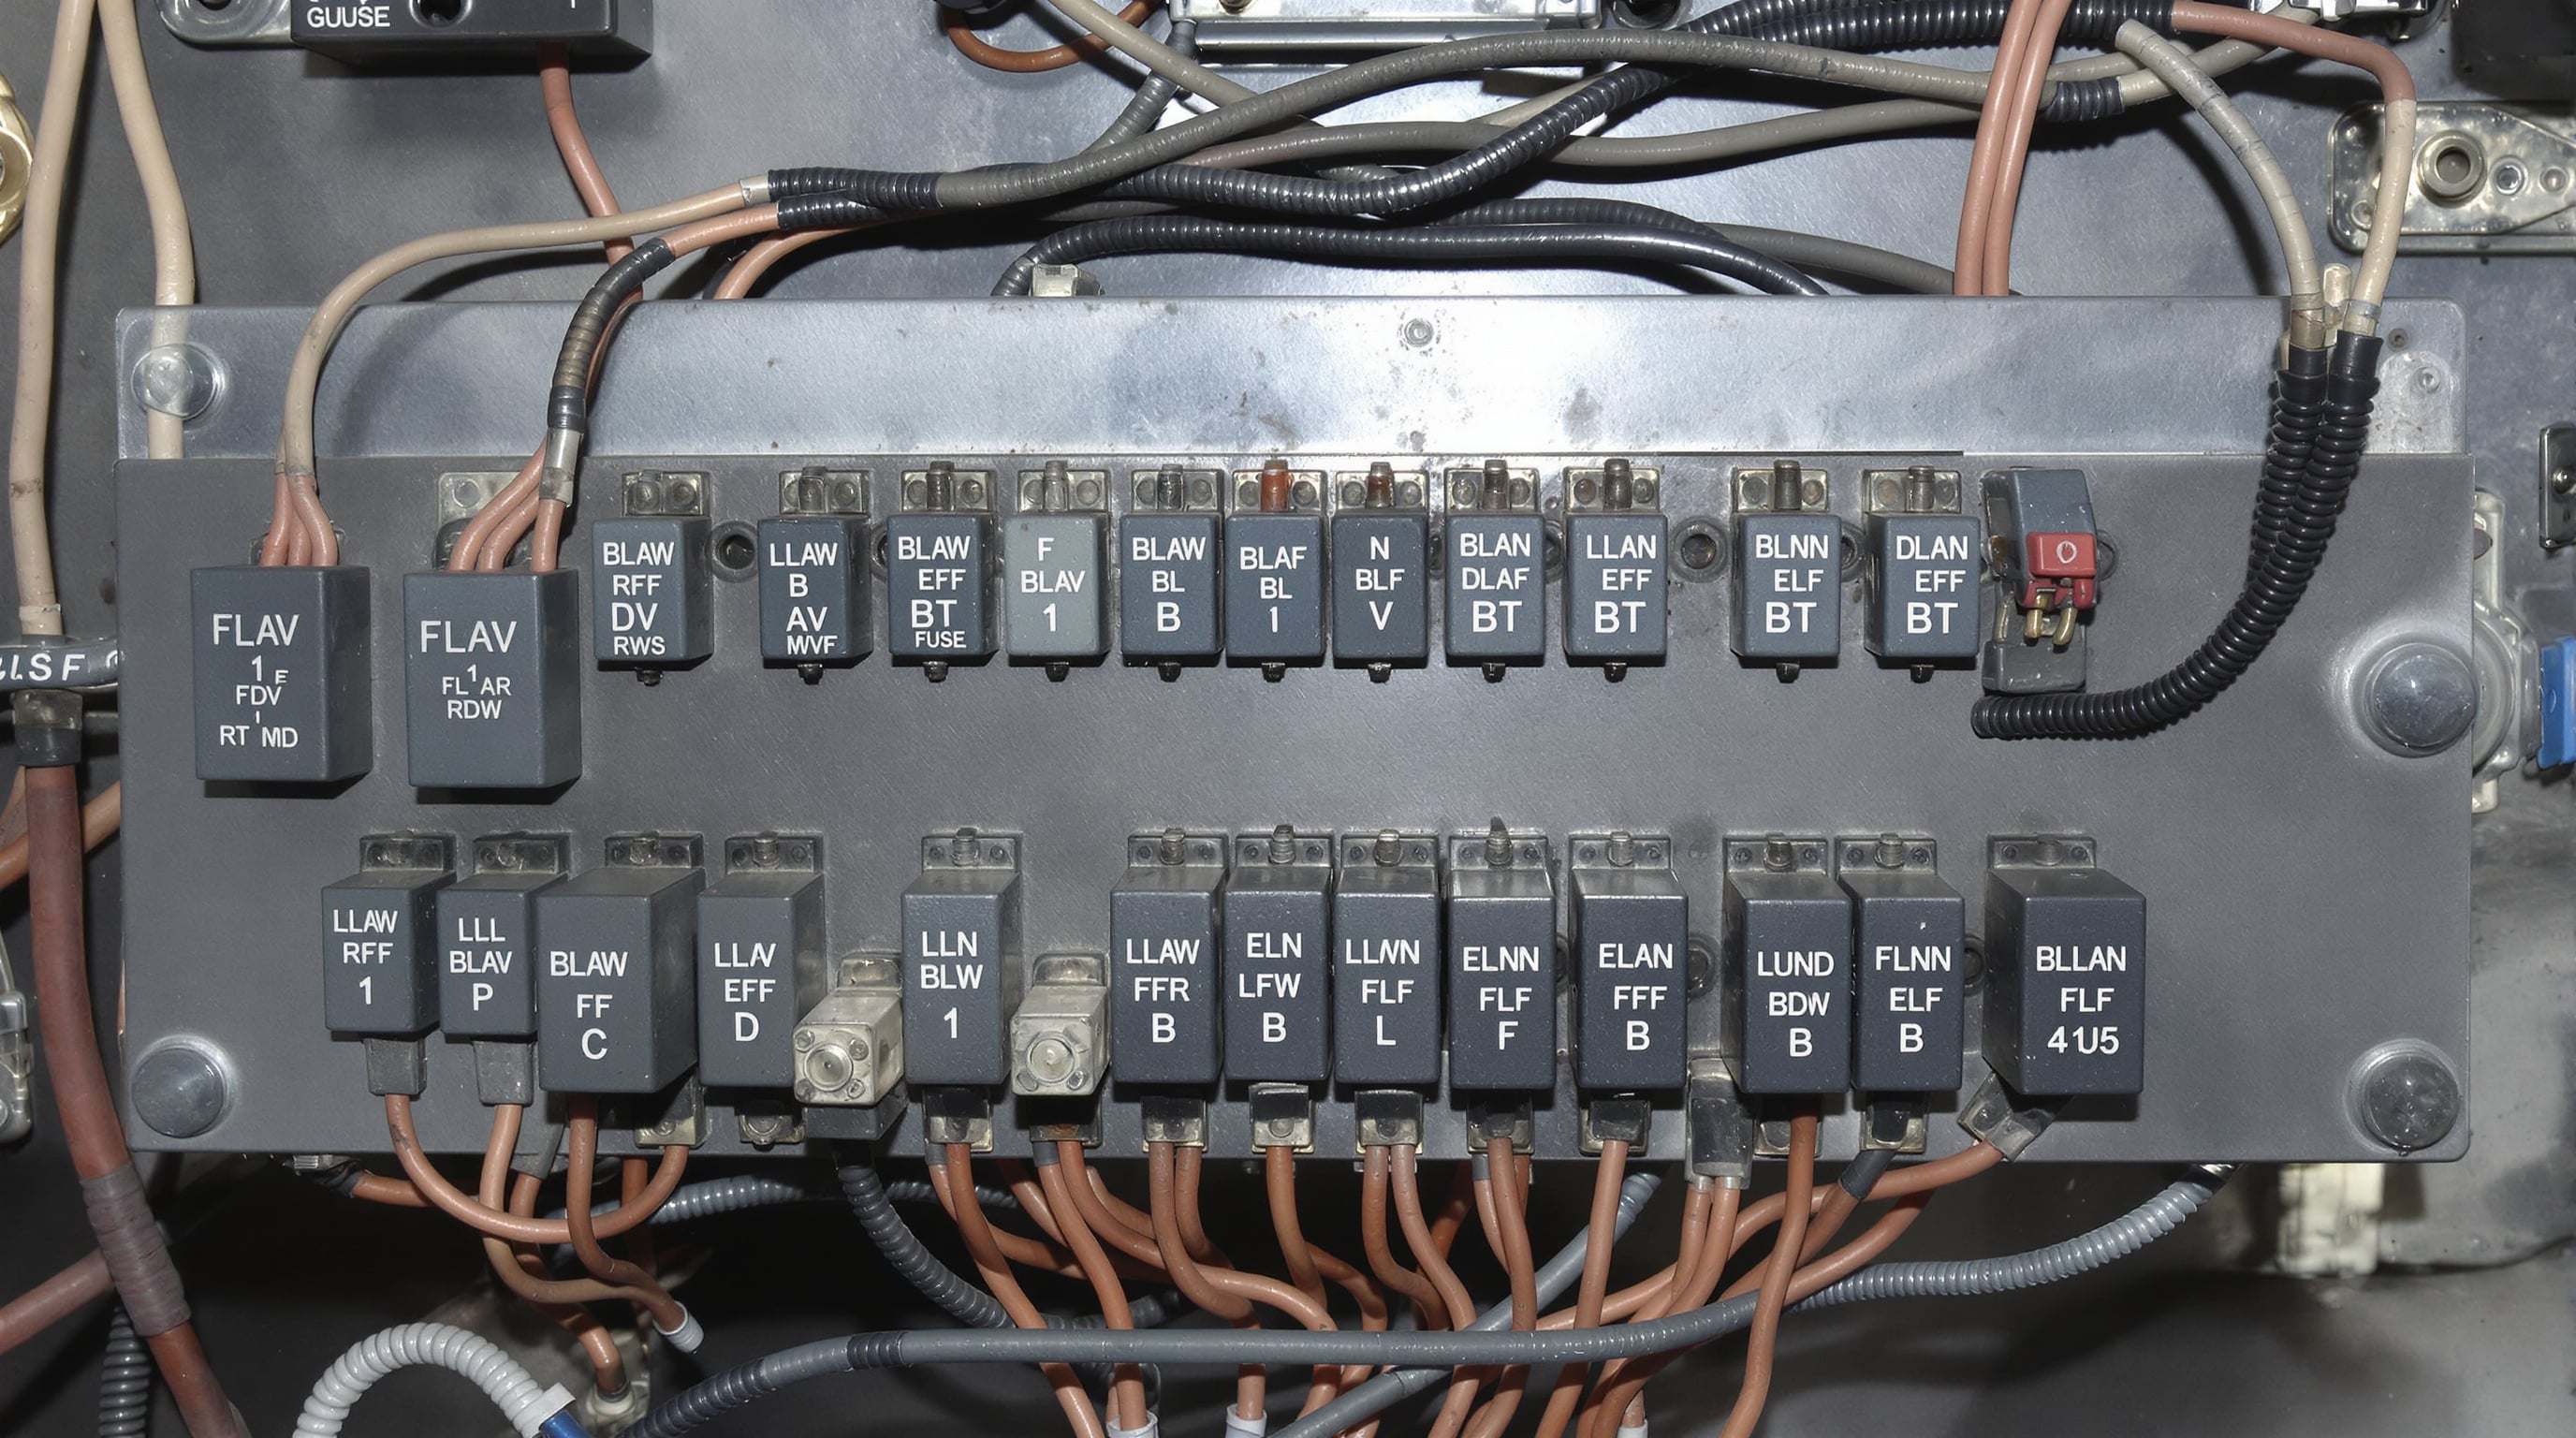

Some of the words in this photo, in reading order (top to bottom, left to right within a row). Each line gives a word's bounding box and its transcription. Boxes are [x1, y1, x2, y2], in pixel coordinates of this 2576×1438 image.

[307, 6, 389, 27] GUUSE
[603, 541, 674, 565] BLAW
[769, 542, 837, 565] LLAW
[898, 536, 970, 560] BLAW
[1038, 536, 1054, 561] F
[1132, 536, 1206, 560] BLAW
[1370, 536, 1389, 559] N
[1459, 532, 1530, 556] BLAN
[1587, 534, 1656, 559] LLAN
[1755, 534, 1828, 558] BLNN
[1895, 535, 1968, 559] DLAN
[1239, 546, 1307, 569] BLAF
[612, 574, 662, 595] RFF
[789, 573, 808, 596] B
[918, 568, 966, 590] EFF
[1020, 569, 1085, 593] BLAV
[1151, 570, 1185, 592] BL
[1260, 577, 1292, 598] BL
[1355, 568, 1404, 590] BLF
[1461, 566, 1530, 590] DLAF
[1602, 568, 1652, 590] EFF
[1774, 568, 1823, 592] ELF
[1915, 569, 1966, 592] EFF
[611, 602, 657, 631] DV
[785, 606, 827, 631] AV
[911, 599, 957, 627] BT
[1043, 603, 1056, 631] 1
[1157, 601, 1180, 631] B
[1269, 606, 1278, 632] 1
[1368, 600, 1393, 630] V
[1472, 600, 1522, 632] BT
[1594, 600, 1646, 633] BT
[1765, 601, 1817, 633] BT
[1907, 601, 1958, 633] BT
[212, 613, 299, 646] FLAV
[420, 620, 517, 653] FLAV
[915, 630, 966, 648] FUSE
[613, 636, 665, 655] RWS
[251, 654, 261, 681] 1
[467, 664, 476, 682] 1
[236, 684, 281, 705] FDV
[442, 676, 468, 695] FL
[480, 676, 511, 696] AR
[447, 699, 502, 718] RDW
[219, 725, 249, 745] RT
[261, 726, 298, 747] MD
[333, 909, 398, 932] LLAW
[458, 917, 505, 942] LLL
[343, 942, 393, 963] RFF
[922, 931, 976, 957] LLN
[1126, 938, 1199, 964] LLAW
[1247, 932, 1301, 958] ELN
[1599, 943, 1672, 968] ELAN
[449, 950, 512, 974] BLAV
[550, 950, 627, 976] BLAW
[1463, 946, 1538, 971] ELNN
[1757, 950, 1834, 976] LUND
[1876, 946, 1950, 971] FLNN
[2036, 946, 2126, 971] BLLAN
[920, 963, 983, 989] BLW
[1134, 976, 1190, 1001] FFR
[1238, 973, 1300, 997] LFW
[359, 976, 371, 1005] 1
[473, 982, 492, 1010] P
[724, 978, 775, 1002] EFF
[1362, 978, 1413, 1004] FLF
[1480, 987, 1531, 1011] FLF
[1614, 985, 1667, 1009] FFF
[1890, 987, 1942, 1011] ELF
[2060, 987, 2114, 1012] FLF
[577, 993, 612, 1018] FF
[1768, 991, 1830, 1016] BDW
[735, 1011, 758, 1041] D
[944, 1006, 957, 1038] 1
[1151, 1012, 1176, 1042] B
[1263, 1012, 1286, 1042] B
[1376, 1015, 1396, 1045] L
[1499, 1020, 1518, 1049] F
[1626, 1020, 1649, 1049] B
[581, 1028, 607, 1059] C
[1789, 1027, 1812, 1056] B
[1899, 1023, 1923, 1052] B
